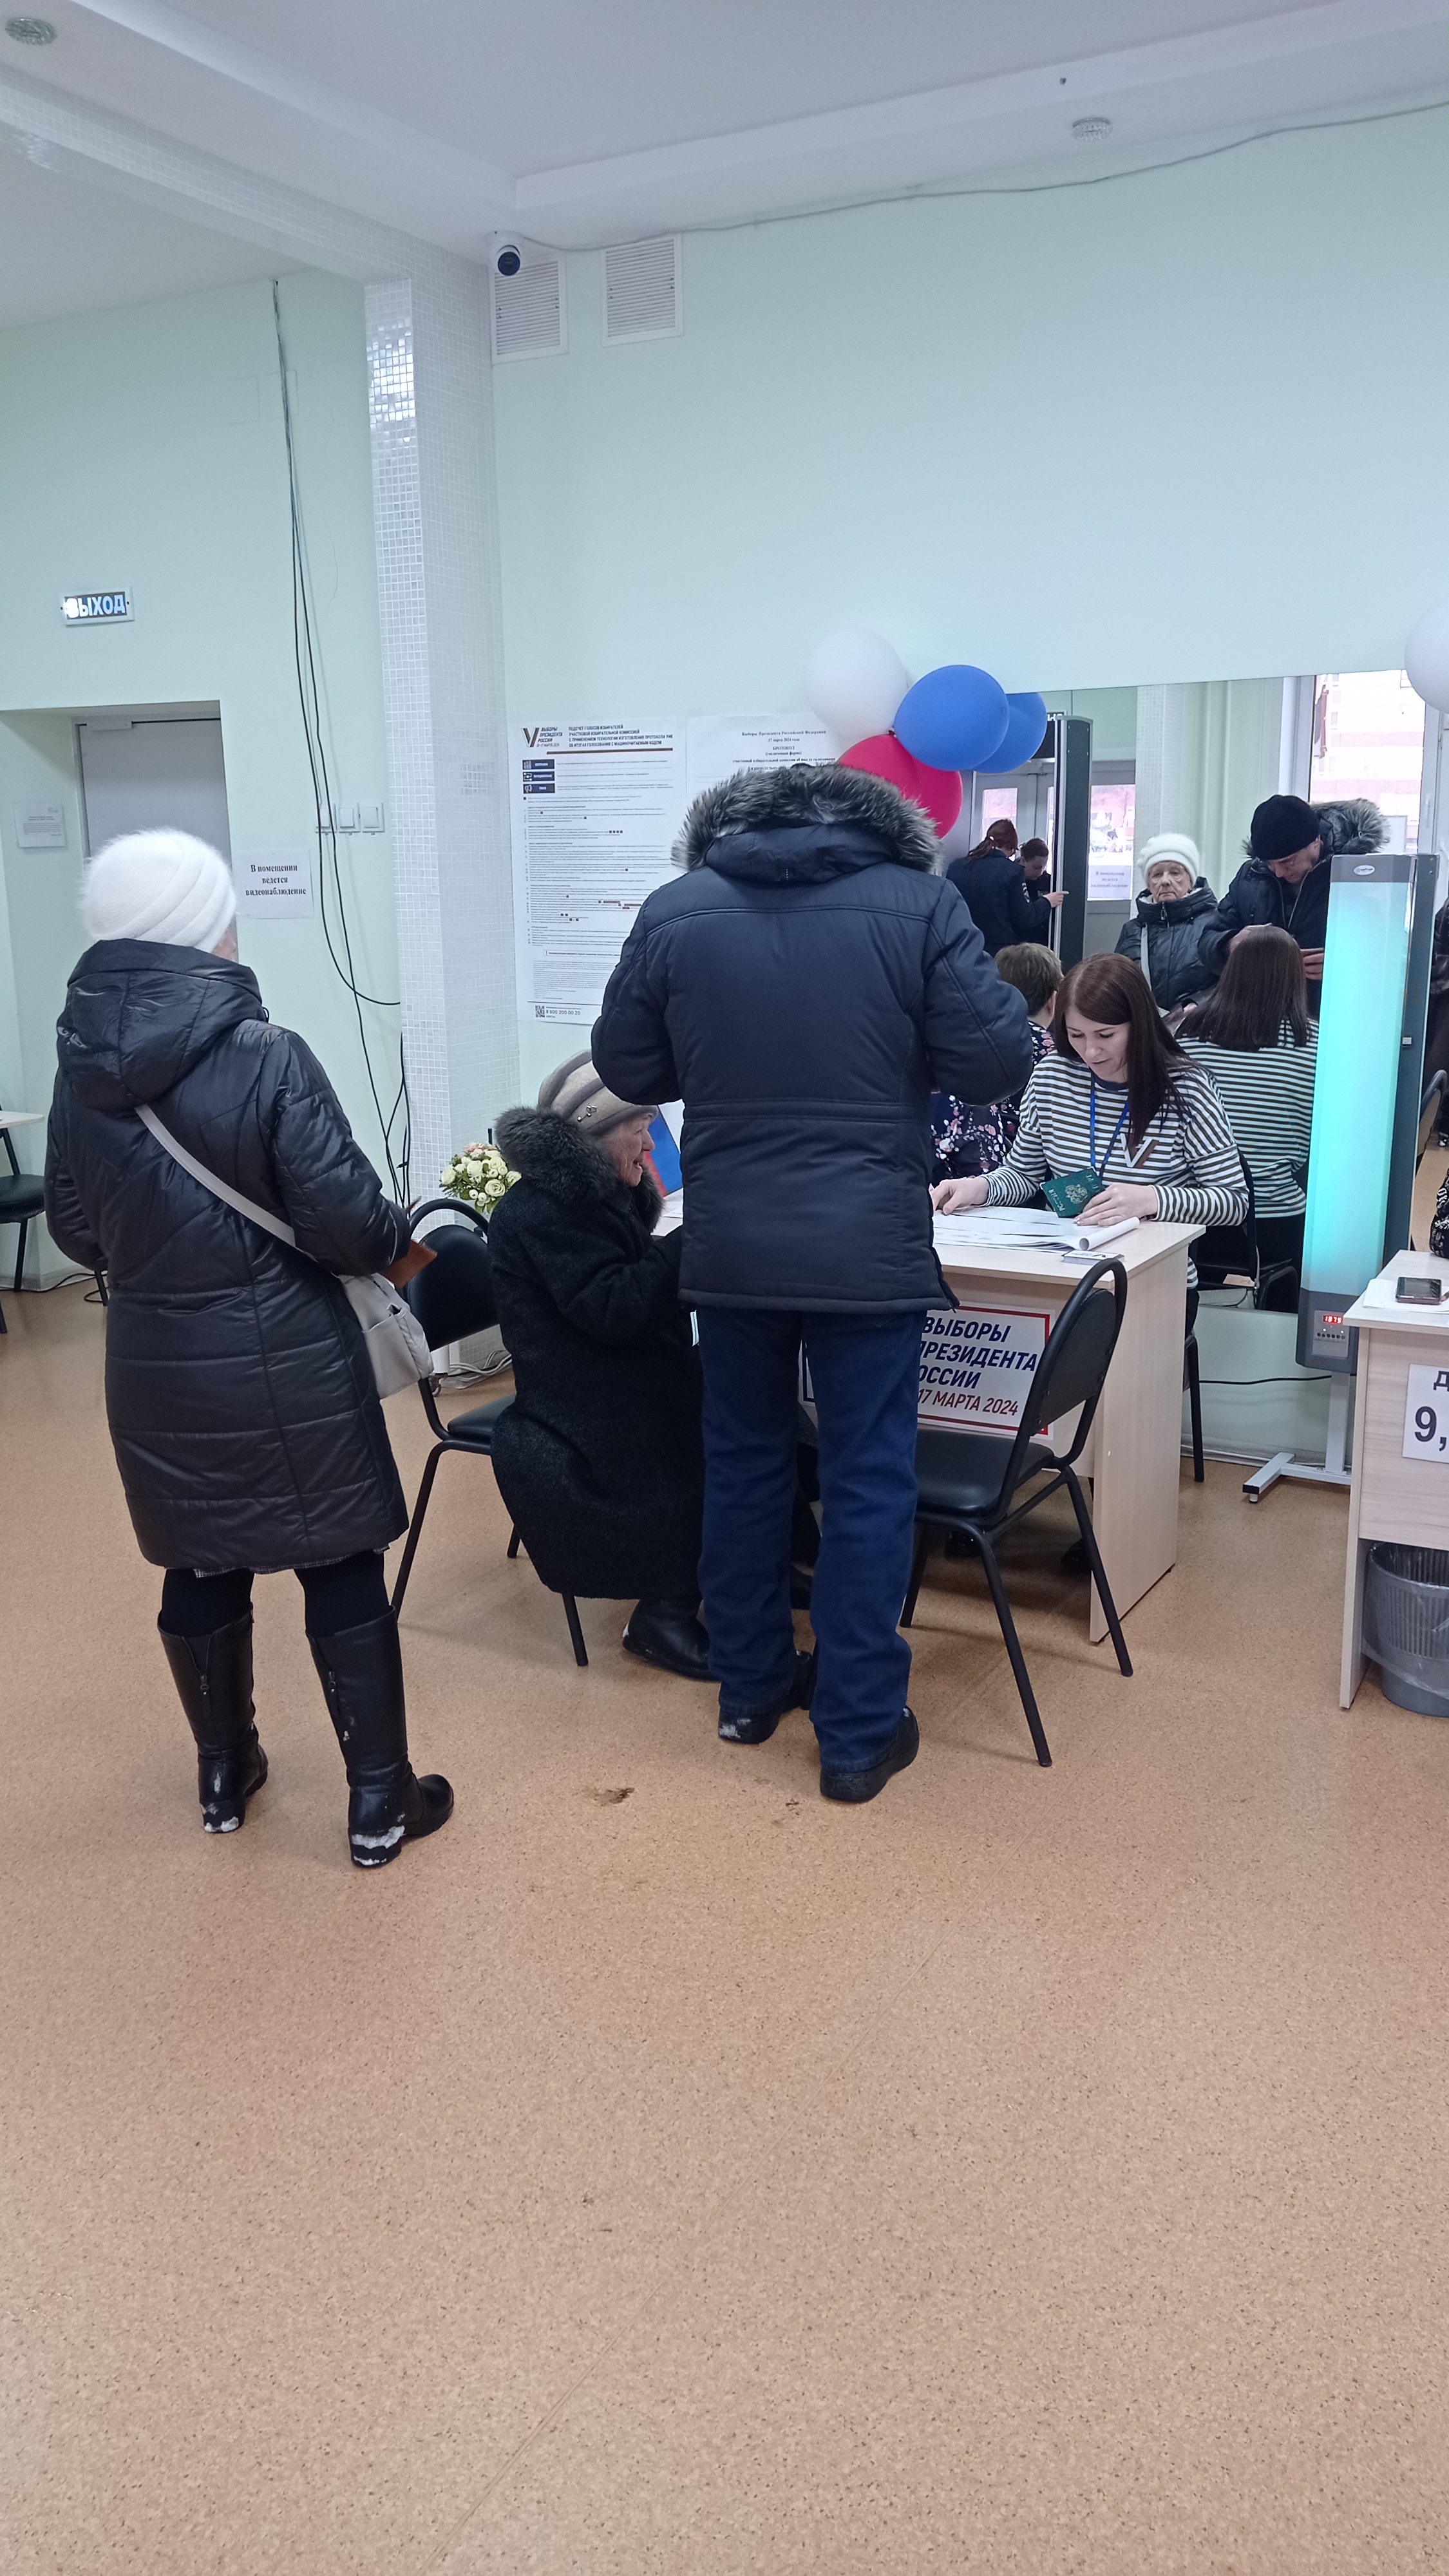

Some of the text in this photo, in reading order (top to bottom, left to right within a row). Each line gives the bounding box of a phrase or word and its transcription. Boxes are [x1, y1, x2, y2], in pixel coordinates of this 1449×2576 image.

[66, 594, 126, 618] ВЫХОД
[245, 887, 307, 896] видеонаблюдение
[923, 1316, 1012, 1343] ВЫБОРЫ
[919, 1365, 981, 1389] ОССИИ
[932, 1390, 981, 1411] МАРТА
[982, 1397, 1019, 1416] 2024
